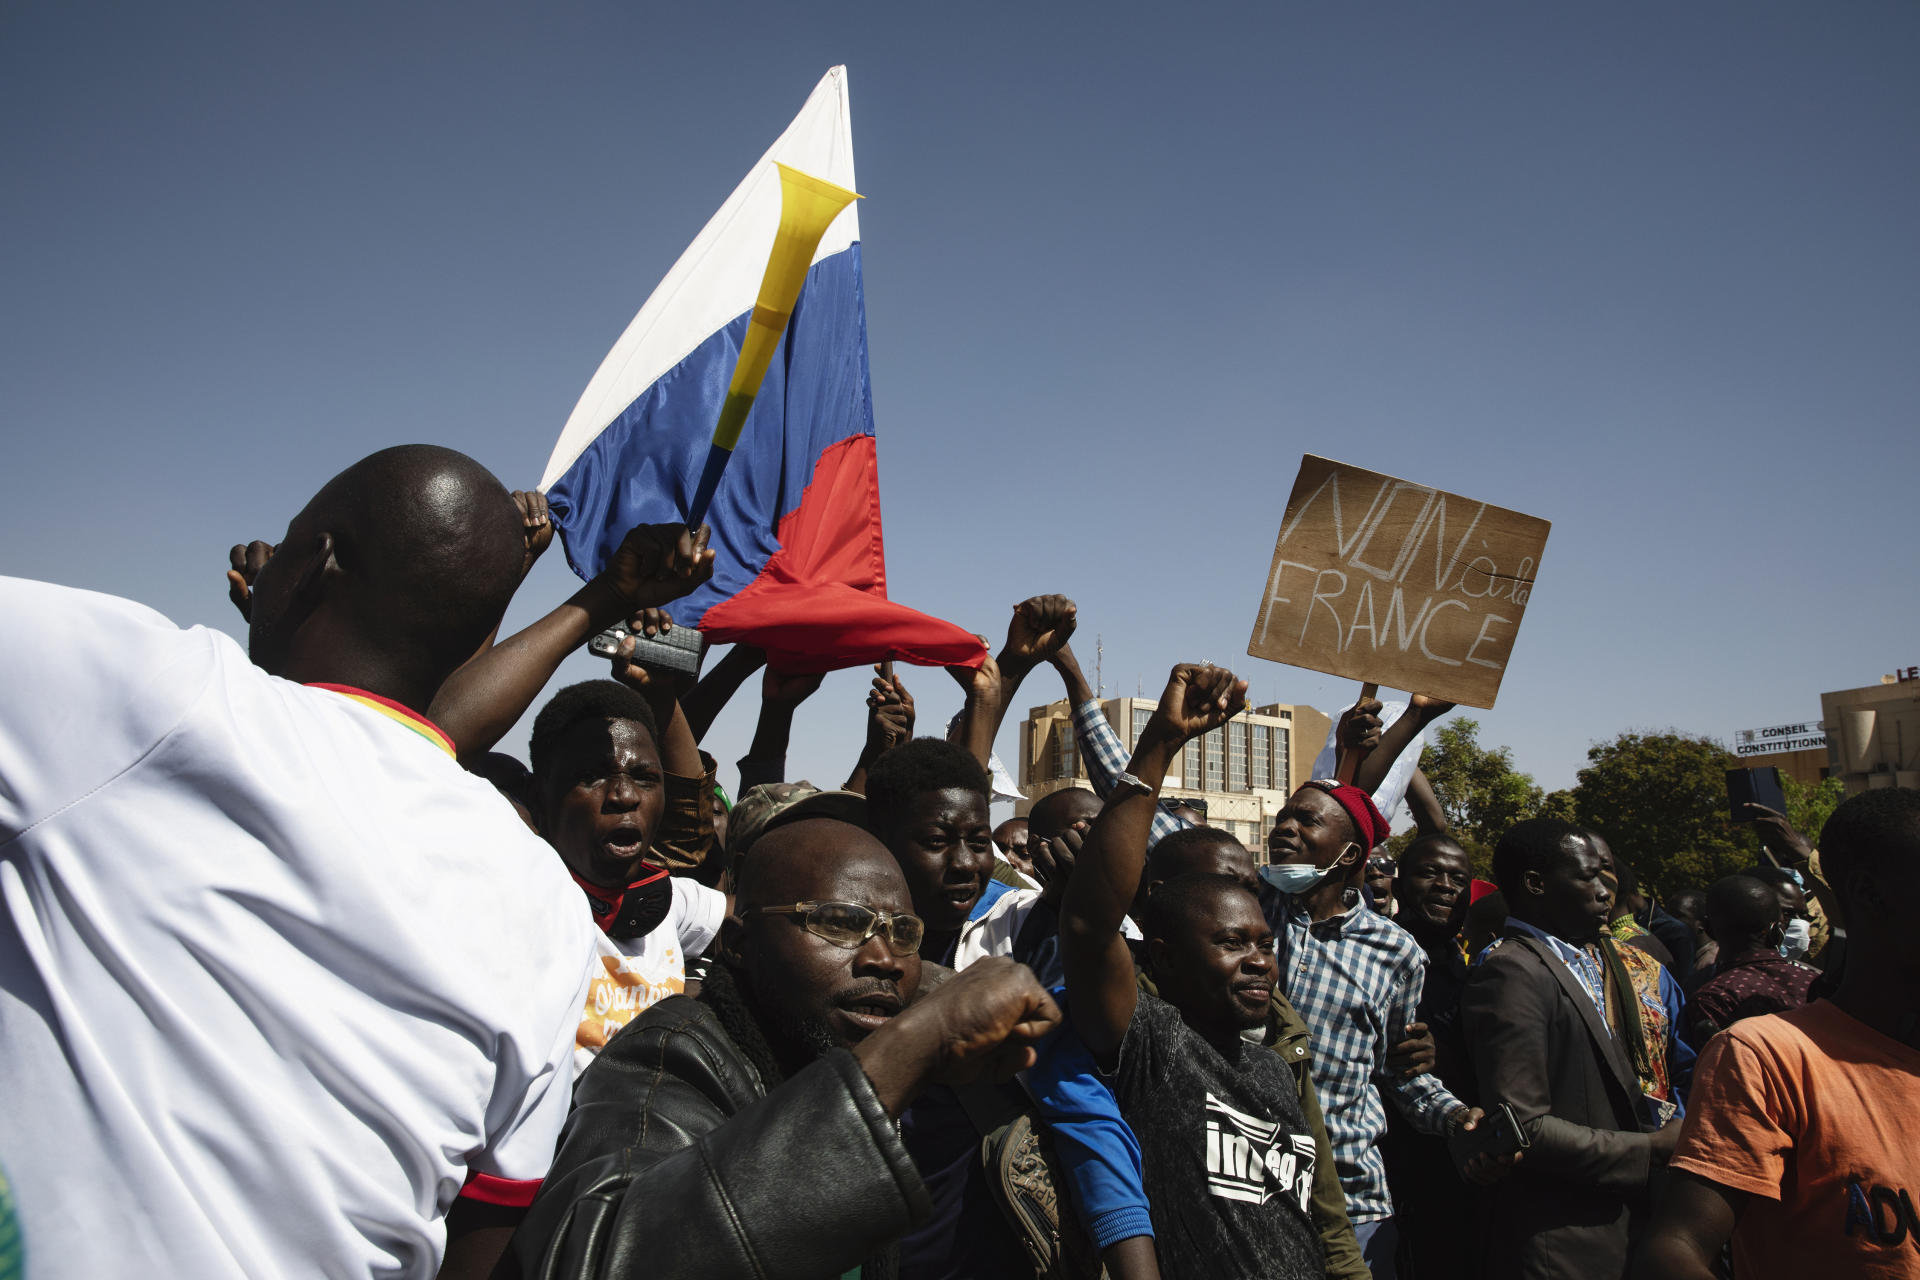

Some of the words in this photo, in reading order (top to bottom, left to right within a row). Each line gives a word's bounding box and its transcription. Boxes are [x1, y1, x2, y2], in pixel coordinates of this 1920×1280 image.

[1279, 471, 1487, 591] NON
[1258, 559, 1513, 669] FRANCE
[1762, 724, 1809, 737] CONSEIL
